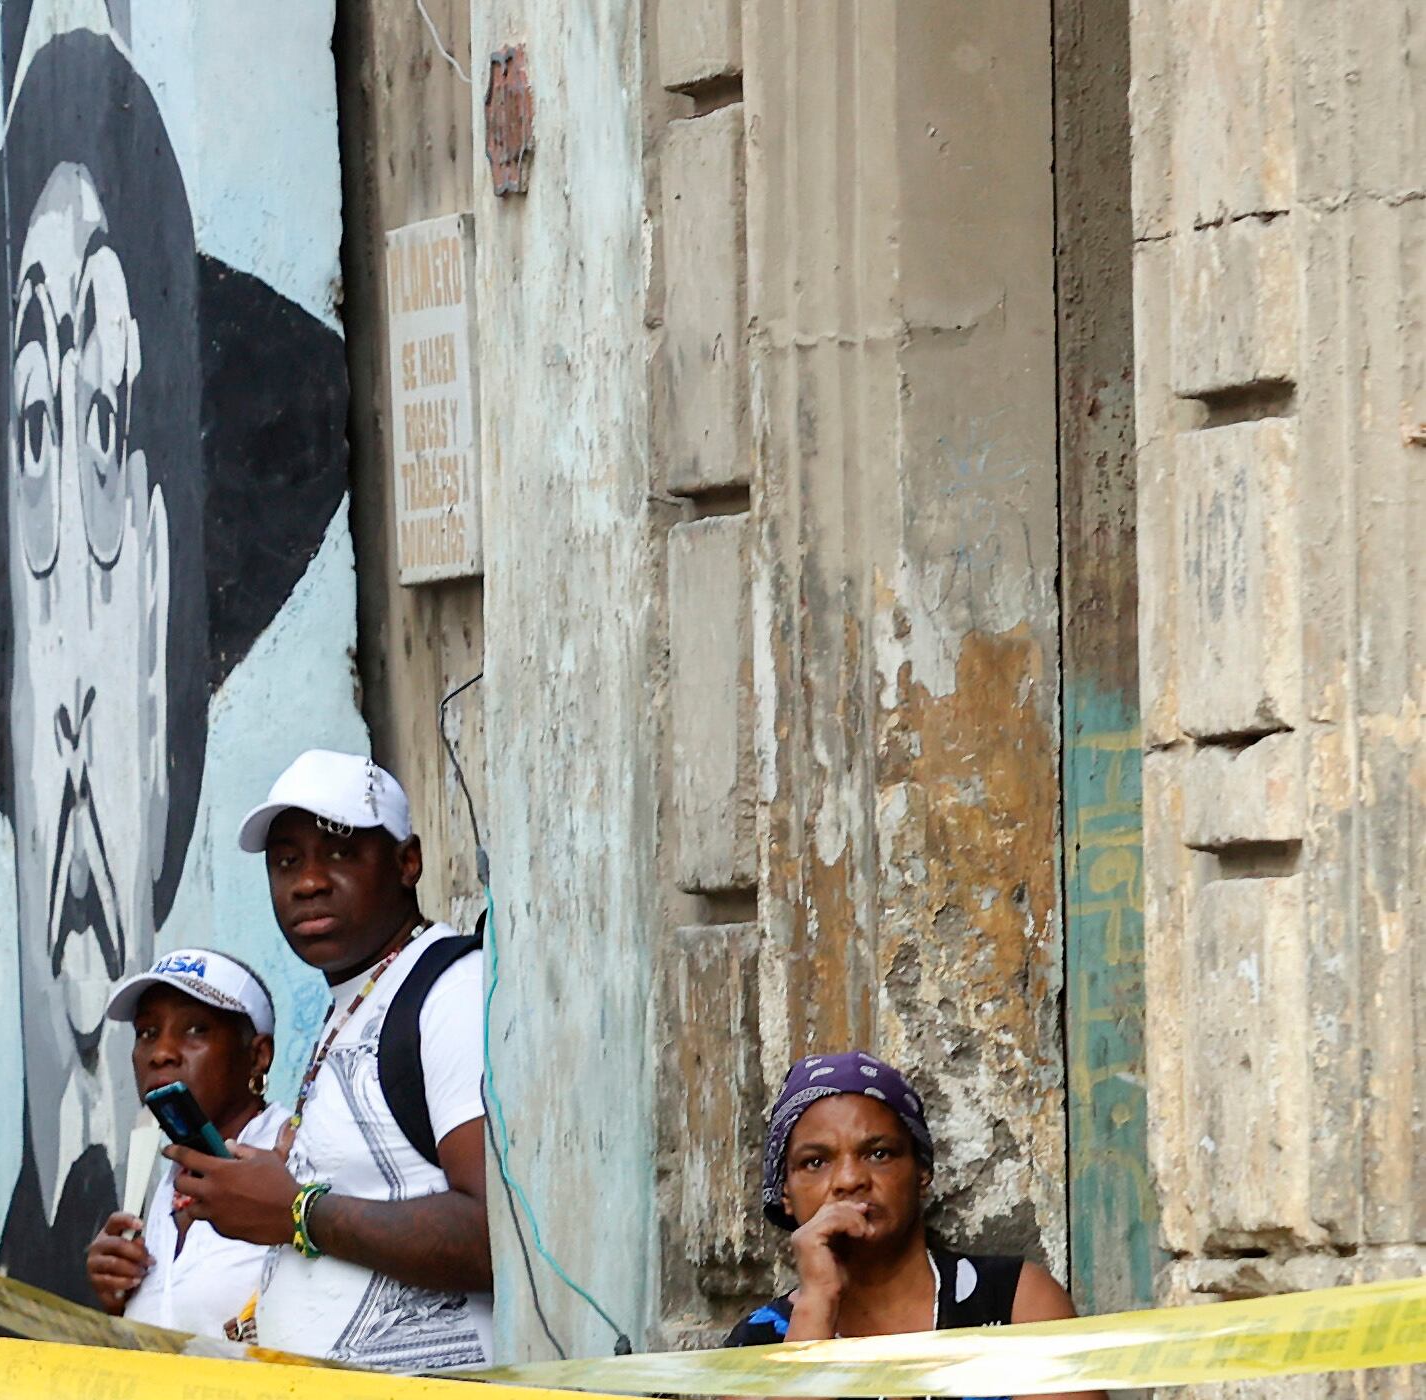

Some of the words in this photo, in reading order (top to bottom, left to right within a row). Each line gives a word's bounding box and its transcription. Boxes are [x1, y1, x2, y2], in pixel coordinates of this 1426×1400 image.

[388, 236, 462, 314] PLOMERO
[402, 342, 417, 391] SE
[419, 332, 456, 387] HACEN
[154, 956, 207, 978] USA
